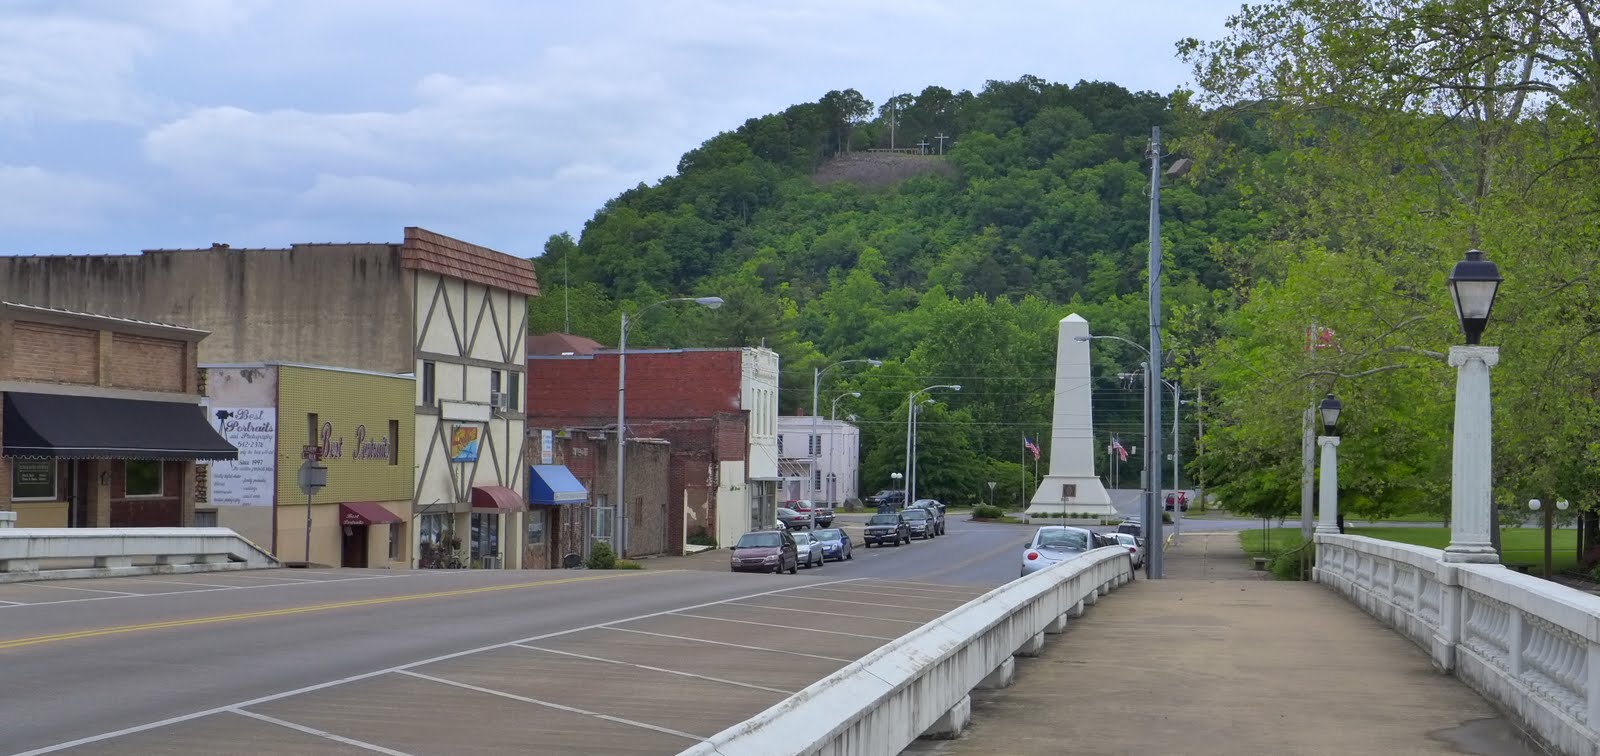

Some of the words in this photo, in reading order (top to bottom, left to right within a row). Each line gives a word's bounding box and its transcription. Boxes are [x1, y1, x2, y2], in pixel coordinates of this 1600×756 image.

[235, 409, 263, 420] Best
[225, 421, 273, 432] Portraits
[321, 421, 342, 459] Best
[353, 424, 390, 460] Portraits
